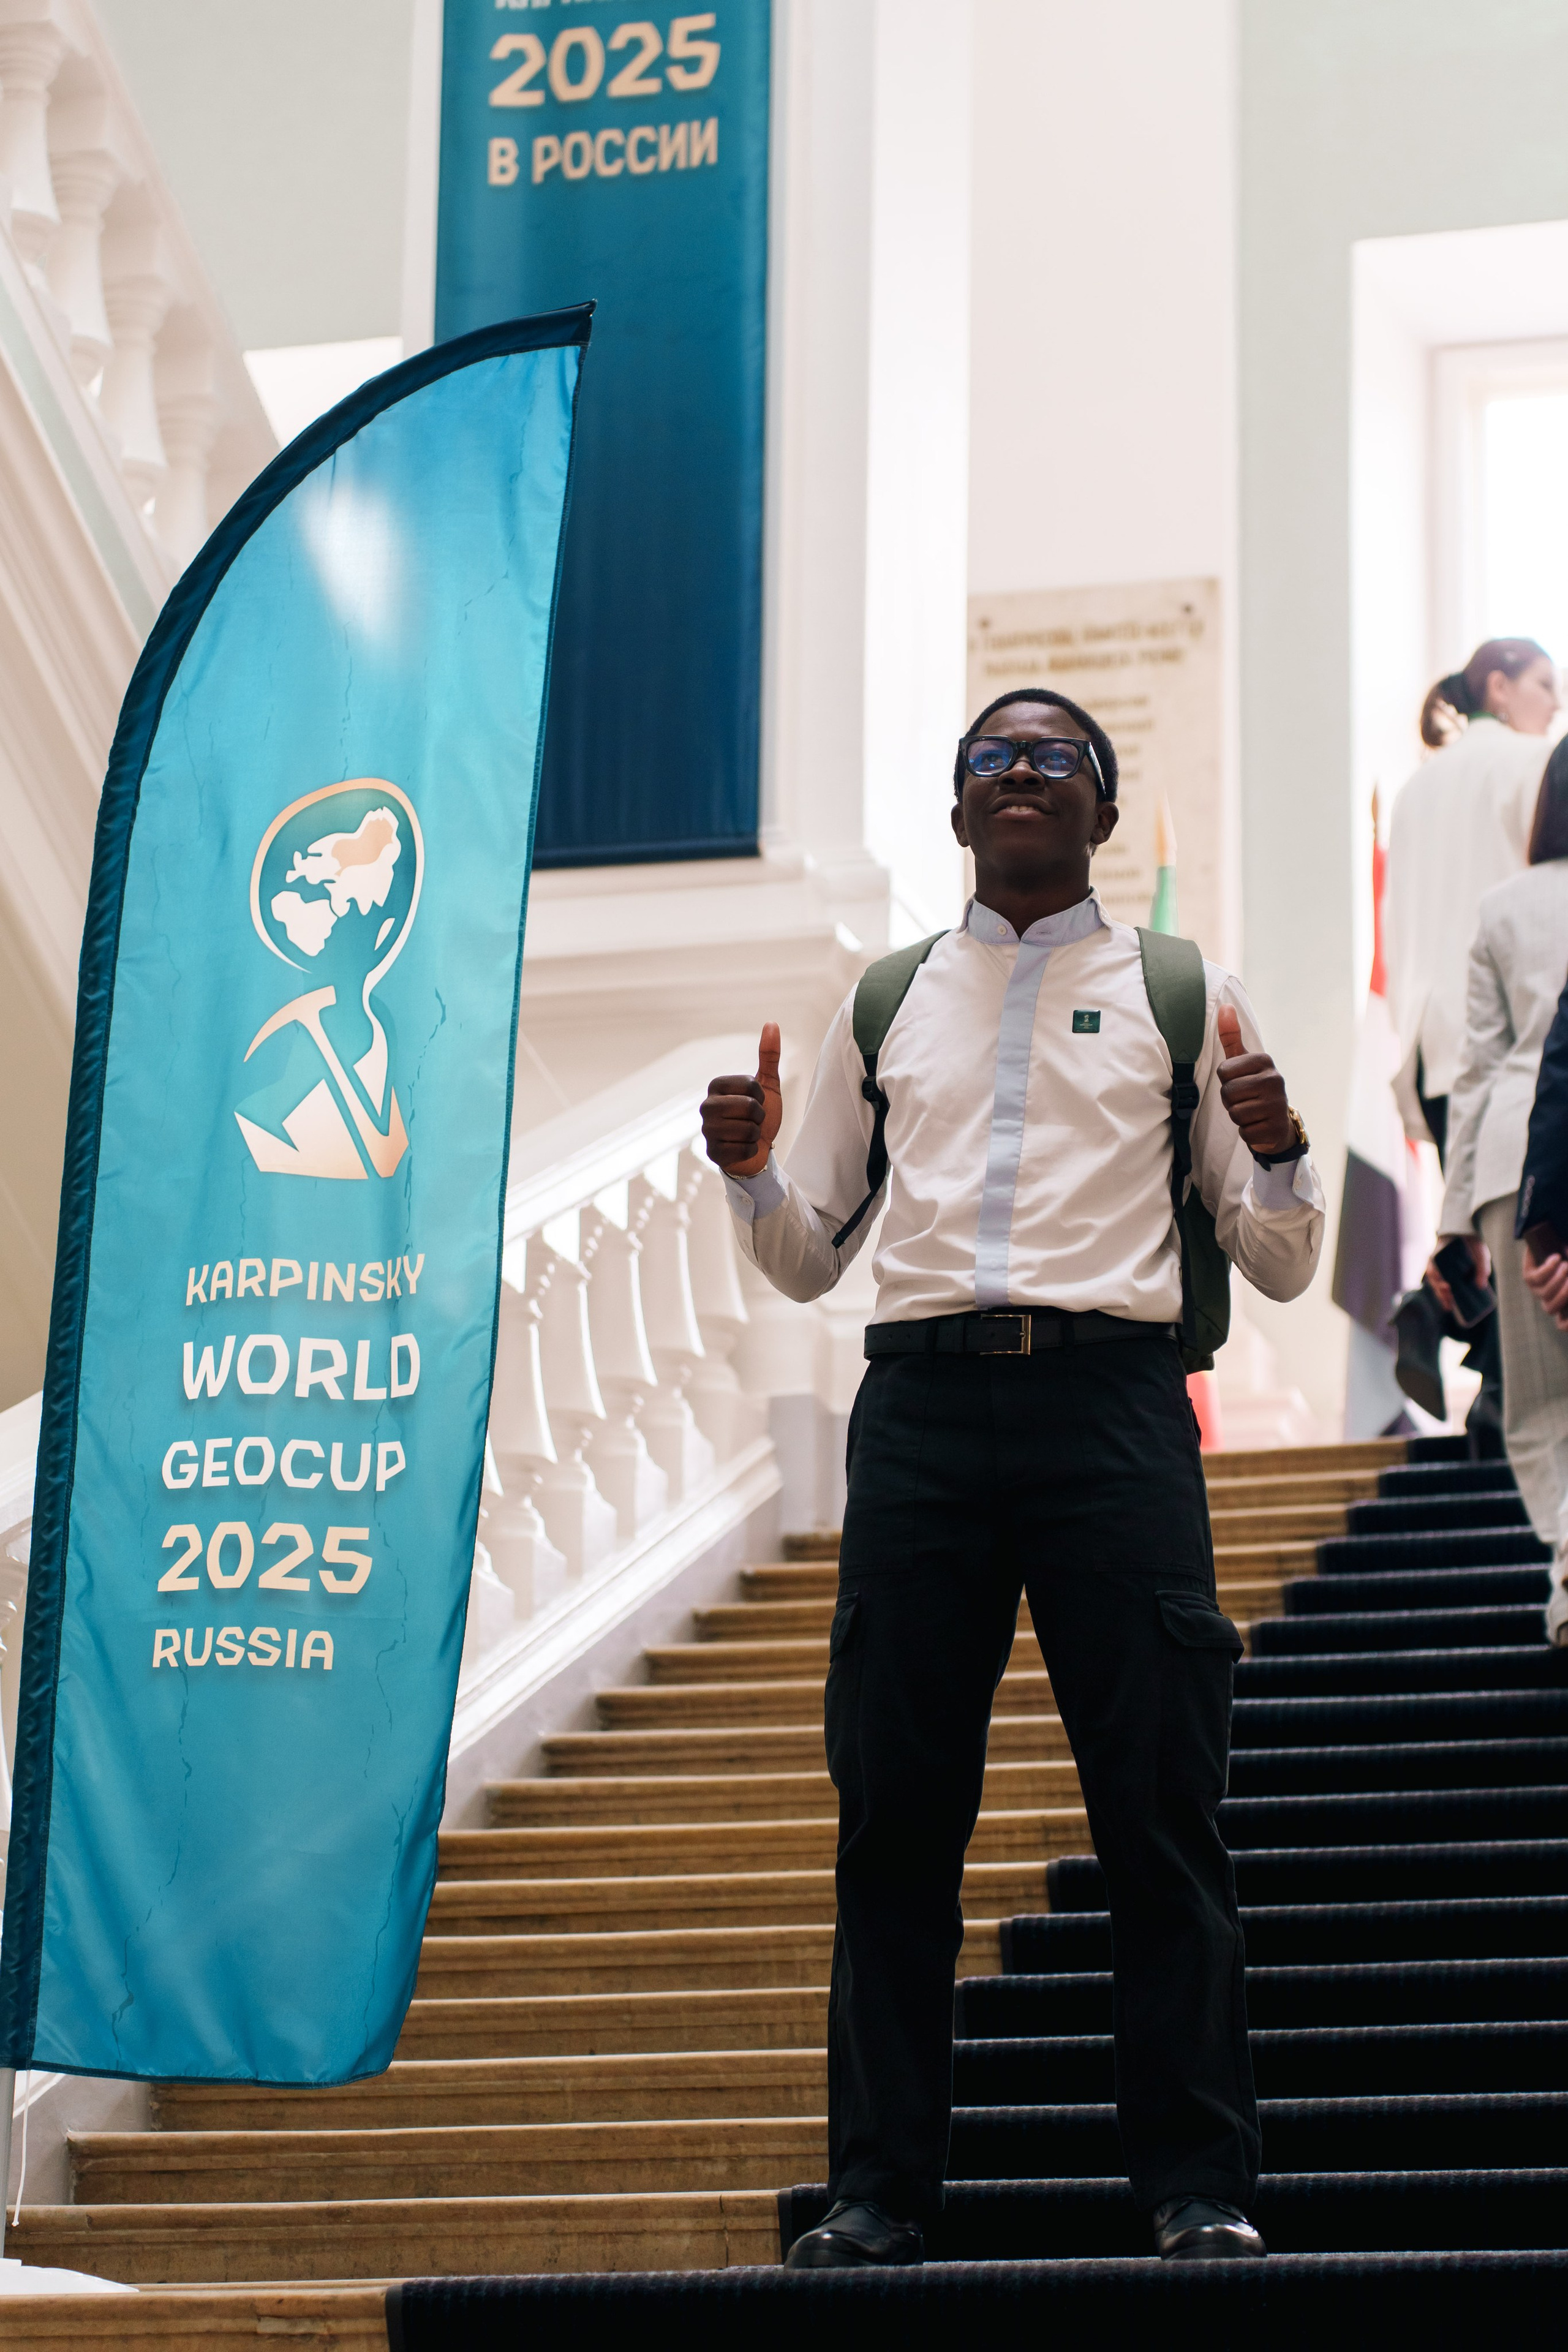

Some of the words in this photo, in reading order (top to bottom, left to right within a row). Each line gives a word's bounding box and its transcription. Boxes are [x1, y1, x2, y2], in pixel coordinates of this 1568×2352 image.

[489, 13, 720, 107] 2025
[489, 137, 519, 185] В
[532, 118, 718, 183] РОССИИ
[186, 1253, 426, 1306] KARPINSKY
[183, 1333, 421, 1400] WORLD
[162, 1437, 406, 1491] GEOCUP
[157, 1521, 373, 1594] 2025
[152, 1627, 334, 1670] RUSSIA
